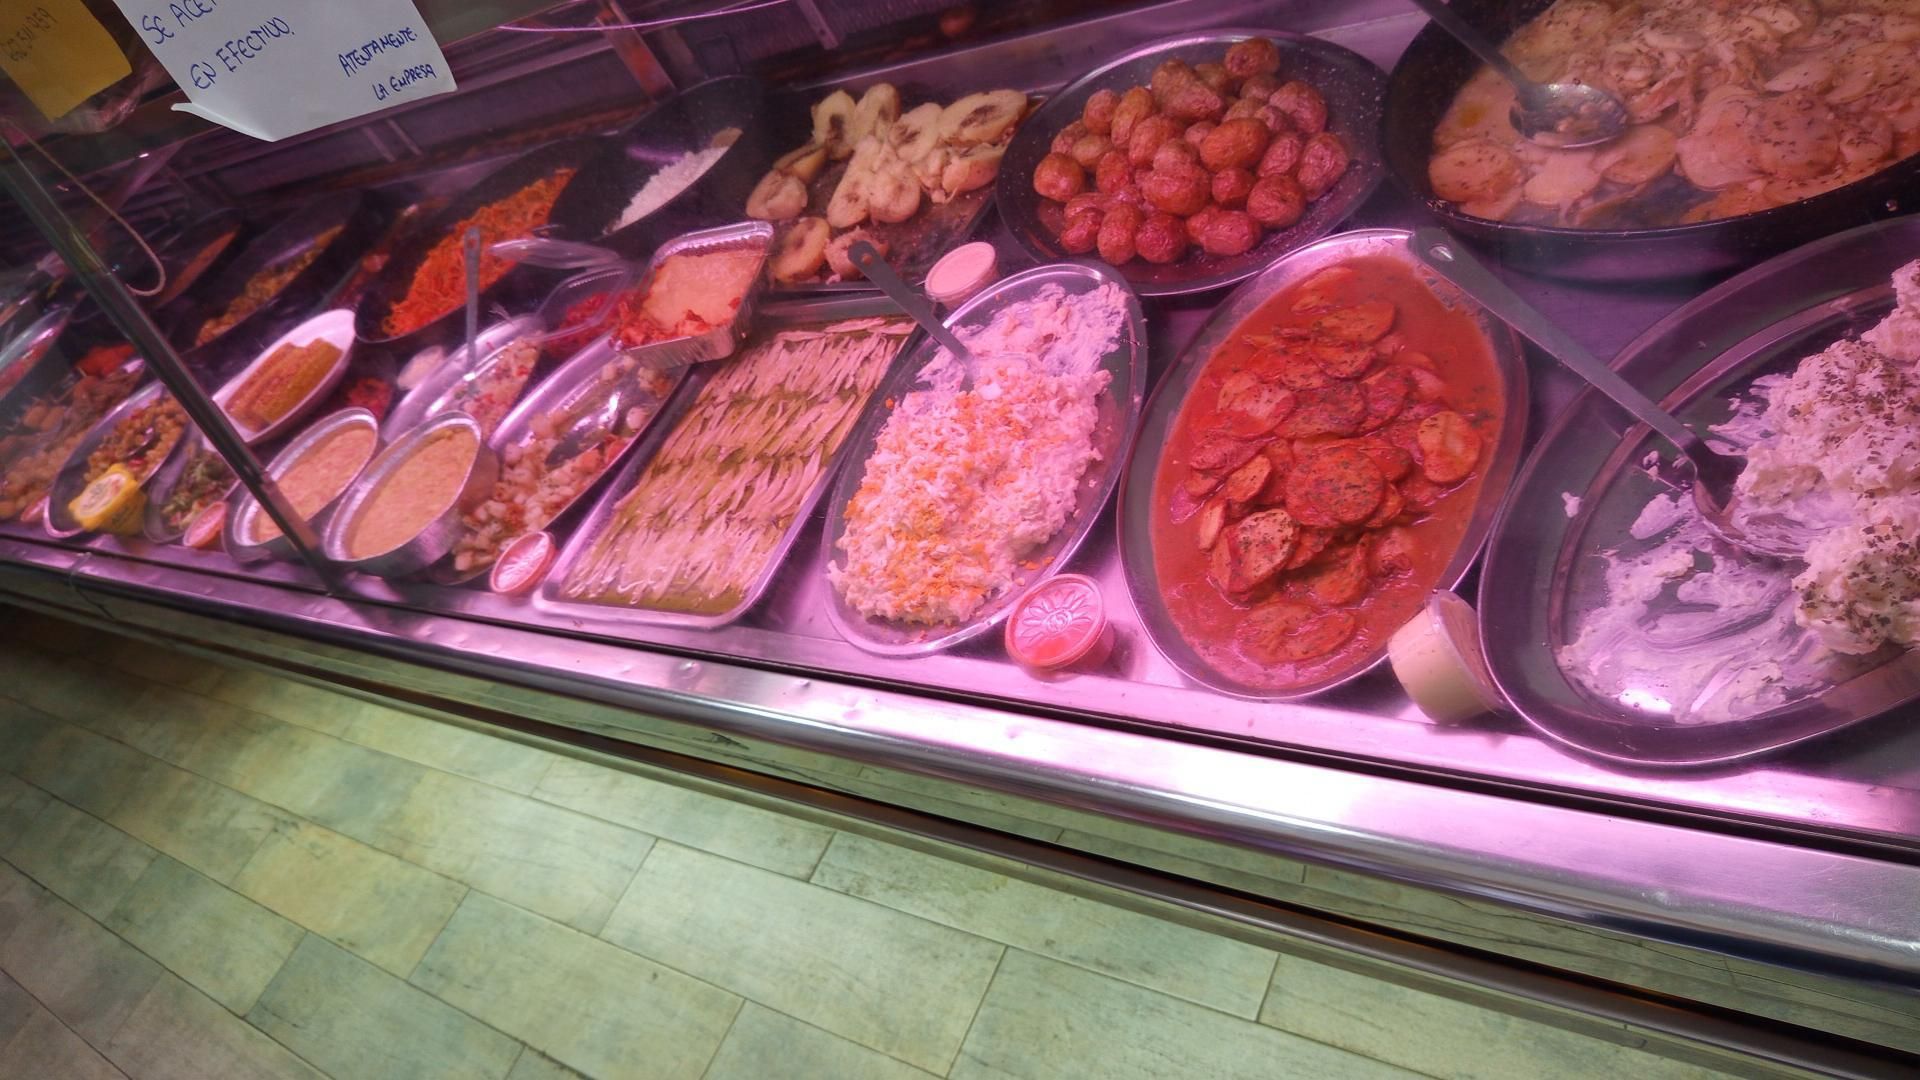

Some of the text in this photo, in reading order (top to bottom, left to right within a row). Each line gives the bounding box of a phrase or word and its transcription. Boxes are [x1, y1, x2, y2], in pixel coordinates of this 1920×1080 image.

[142, 0, 217, 44] SE ACE
[190, 61, 217, 89] EN
[372, 83, 390, 101] LA
